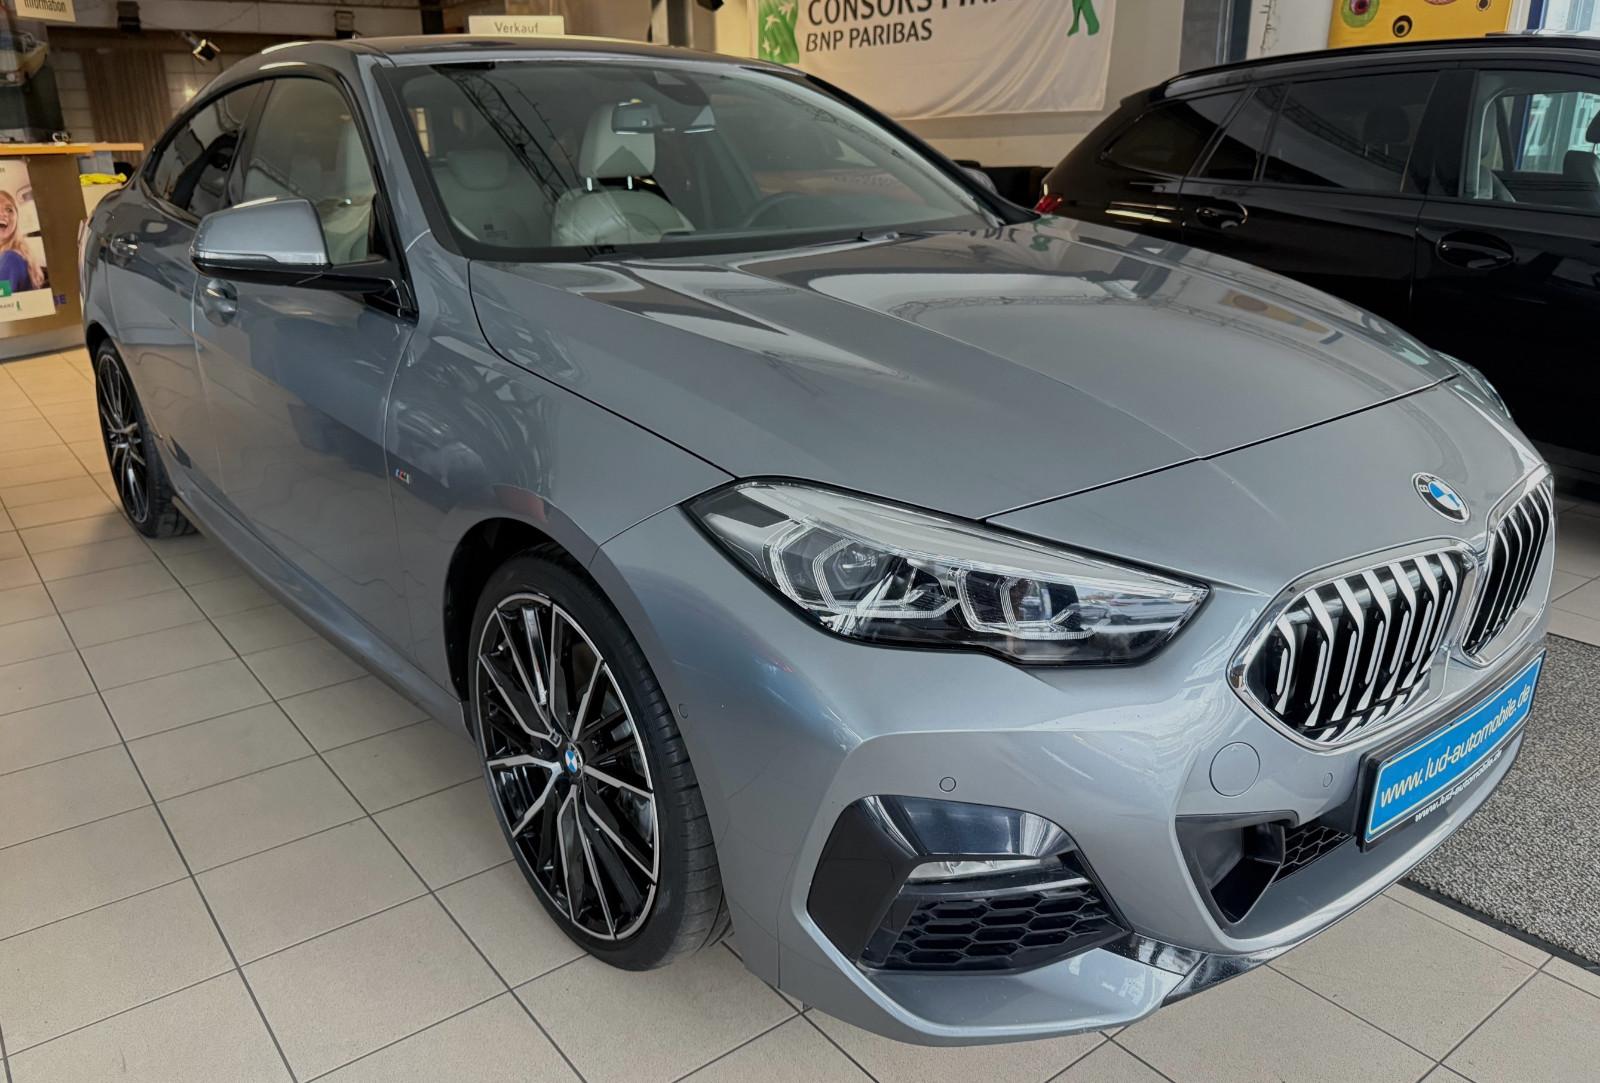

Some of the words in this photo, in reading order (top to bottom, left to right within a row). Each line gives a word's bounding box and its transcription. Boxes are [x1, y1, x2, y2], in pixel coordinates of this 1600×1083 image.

[494, 22, 539, 34] Verkauf
[806, 30, 844, 52] BNP
[849, 18, 932, 49] PARIBAS
[1381, 684, 1531, 808] www.lud-automobile.de
